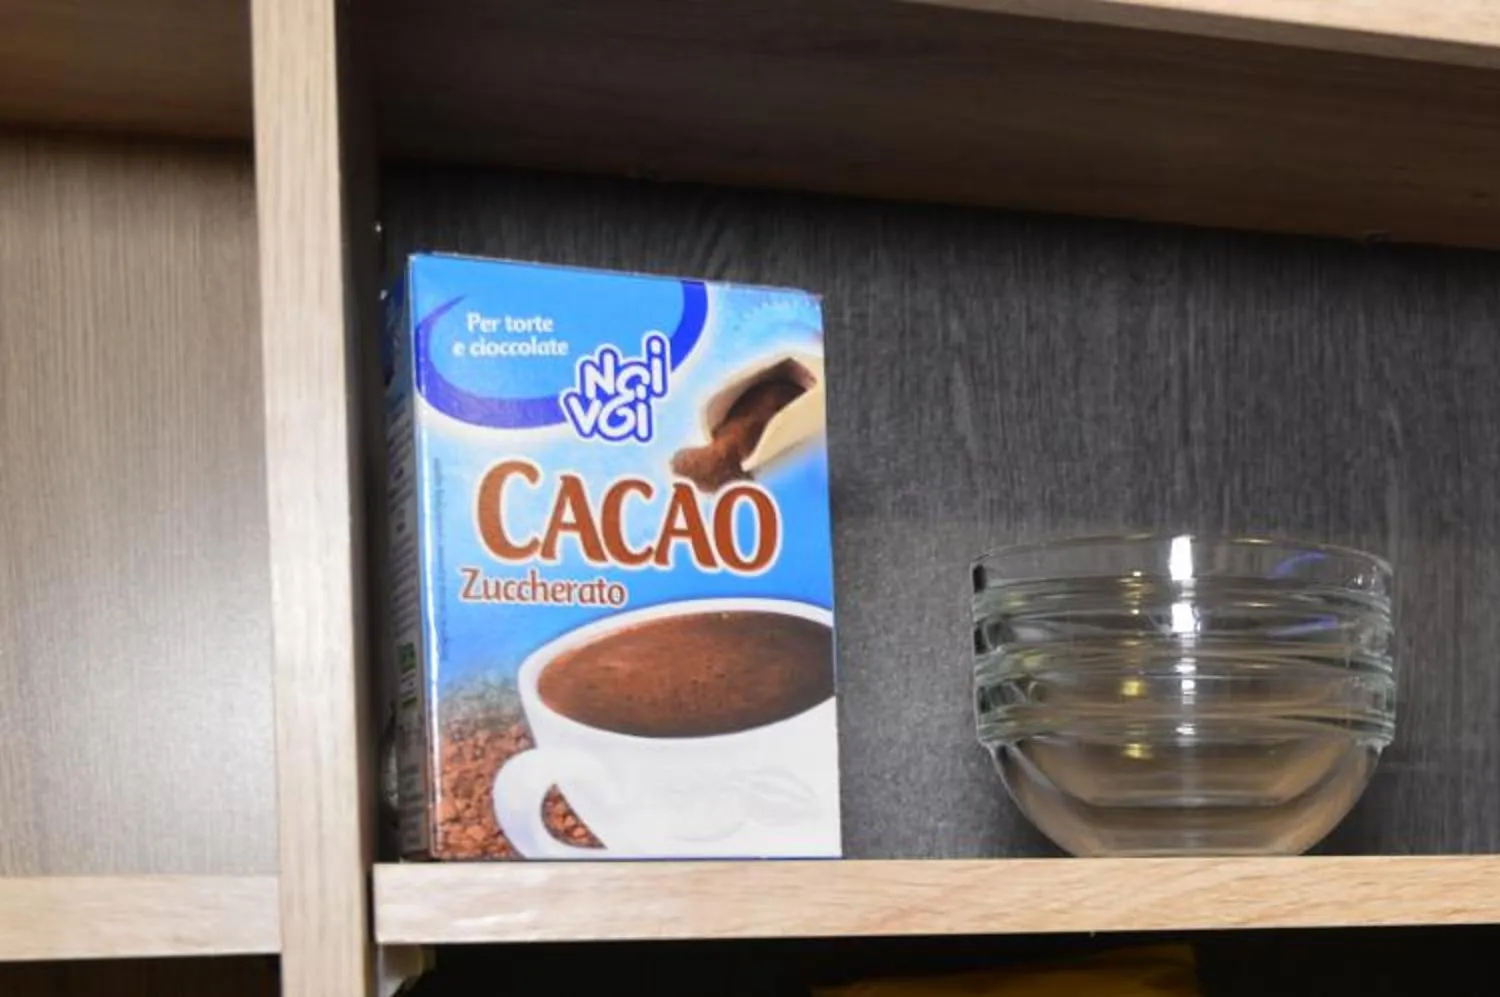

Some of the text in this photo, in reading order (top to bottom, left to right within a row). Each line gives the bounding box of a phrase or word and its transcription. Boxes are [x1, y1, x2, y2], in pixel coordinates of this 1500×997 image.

[466, 312, 554, 333] Per torte
[453, 336, 569, 356] e cioccolate
[475, 460, 782, 573] CACAO
[460, 568, 626, 607] Zuccherato
